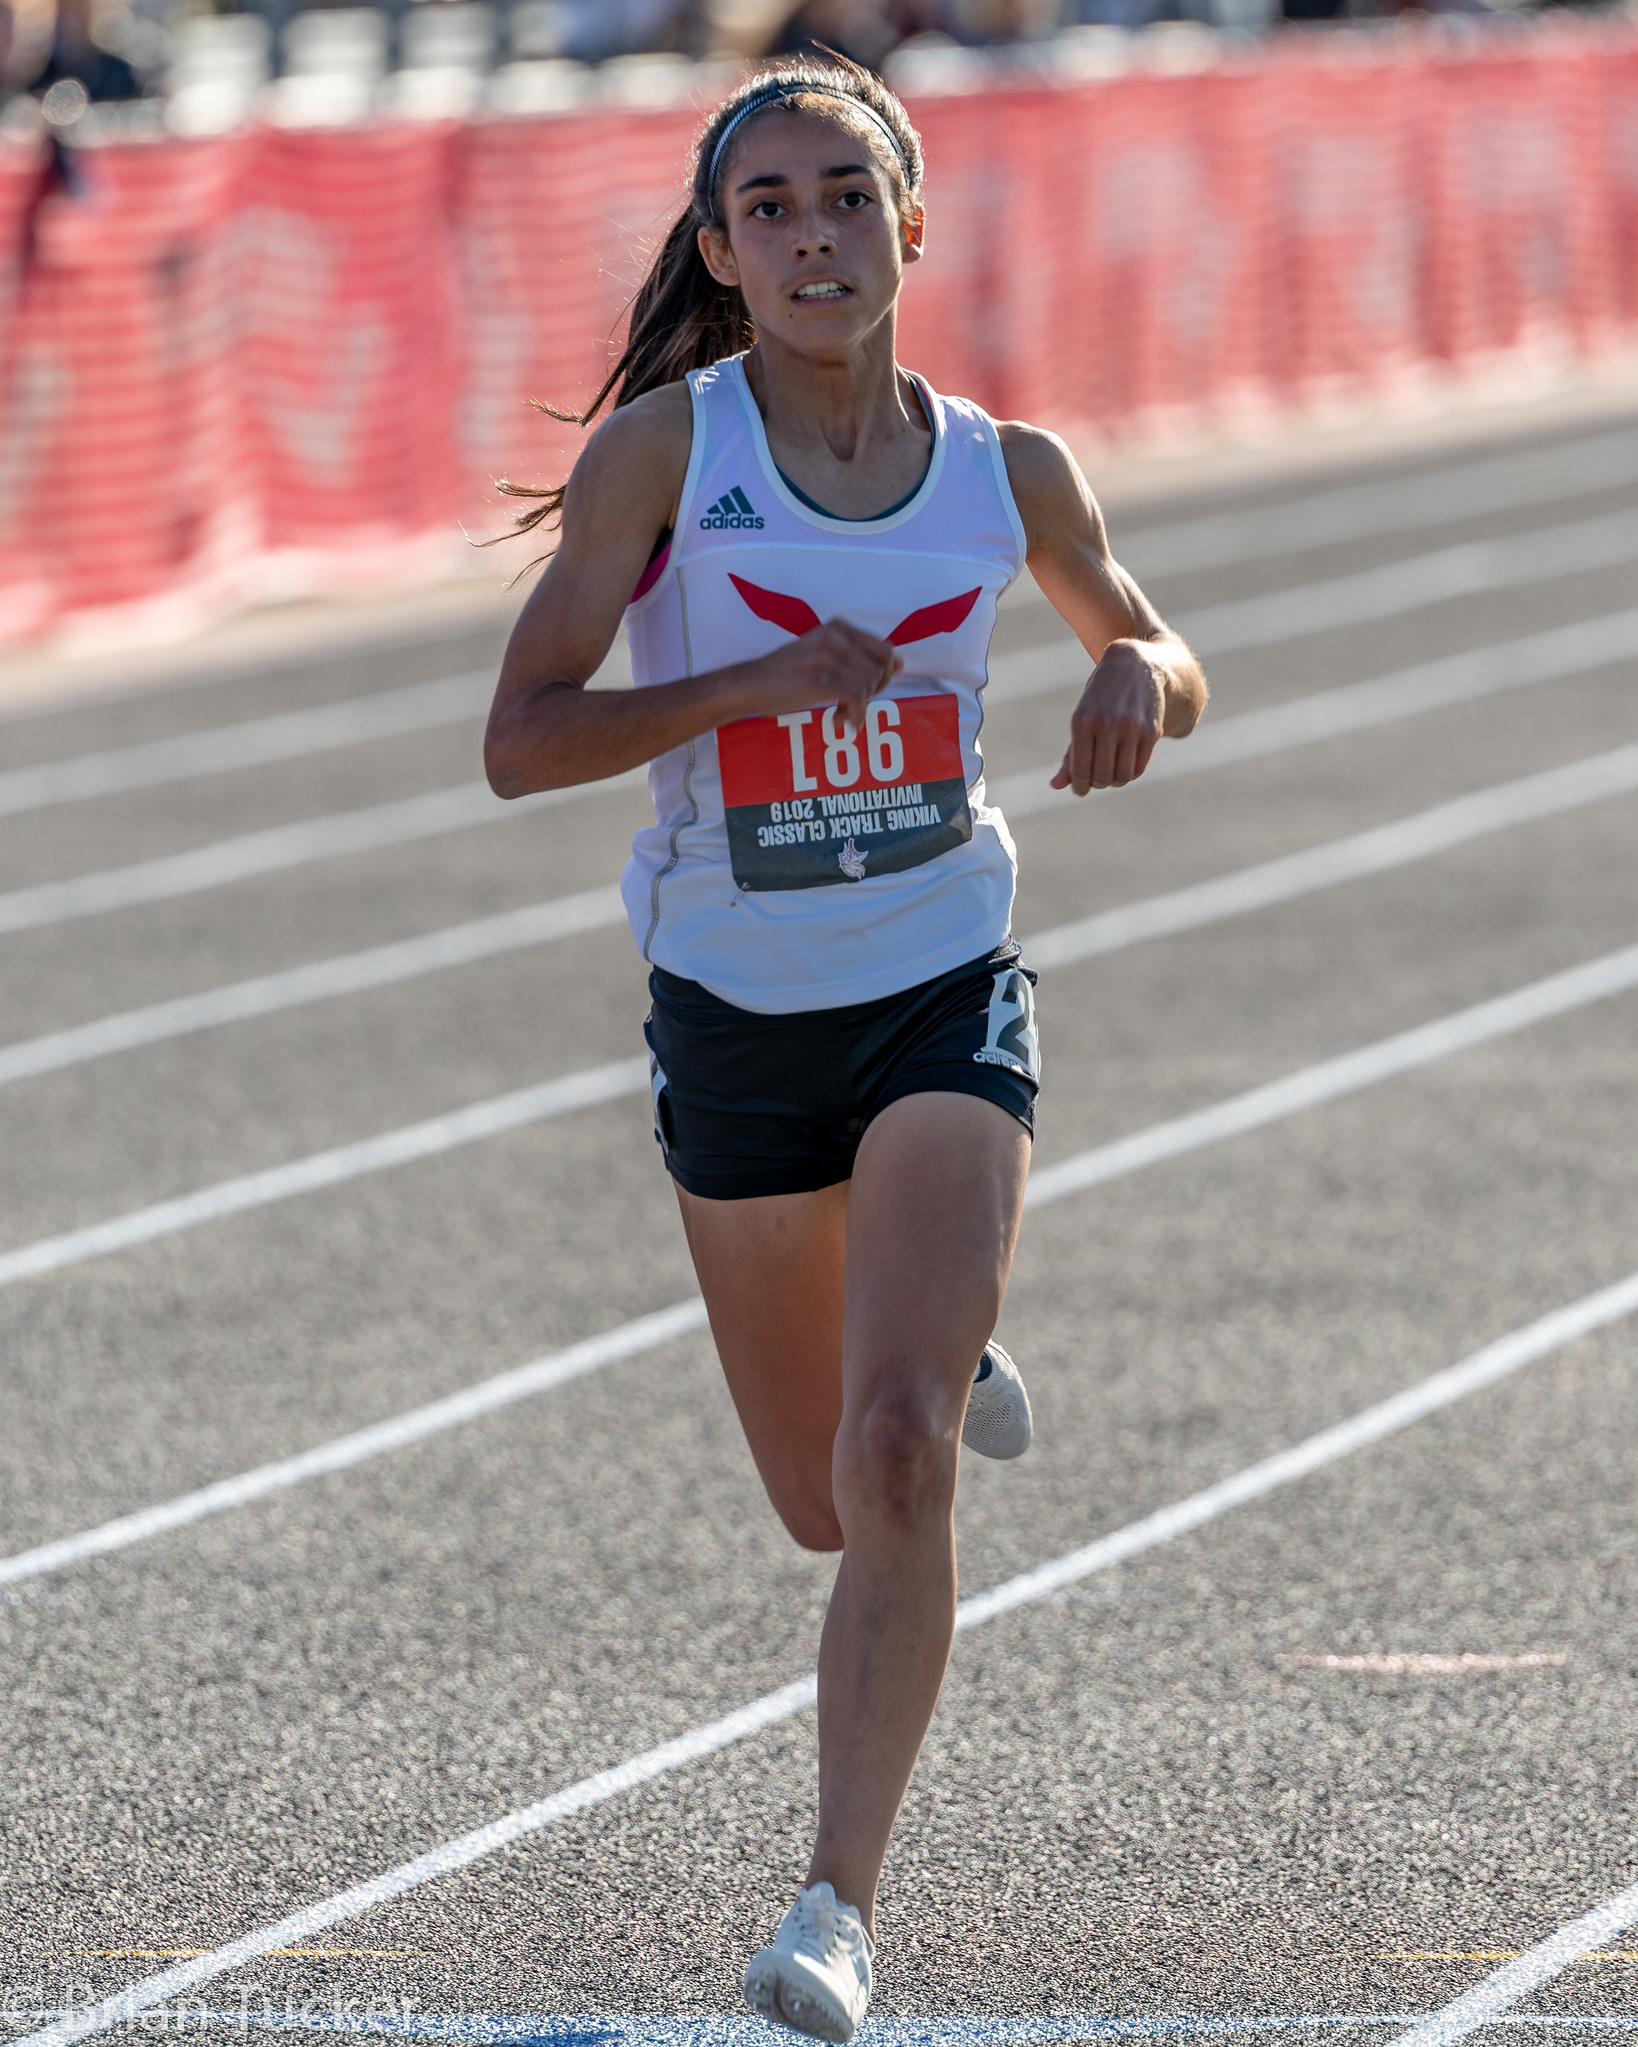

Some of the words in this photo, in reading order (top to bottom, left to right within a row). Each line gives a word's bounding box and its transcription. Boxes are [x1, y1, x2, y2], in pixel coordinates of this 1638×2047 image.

[700, 512, 765, 530] adidas
[777, 699, 904, 793] 981
[770, 799, 815, 823] 2019
[817, 783, 923, 817] INVITATIONAL
[830, 811, 883, 839] TRACK
[888, 804, 942, 831] VIKING
[757, 820, 826, 848] CLASSIC
[996, 972, 1029, 1066] 2
